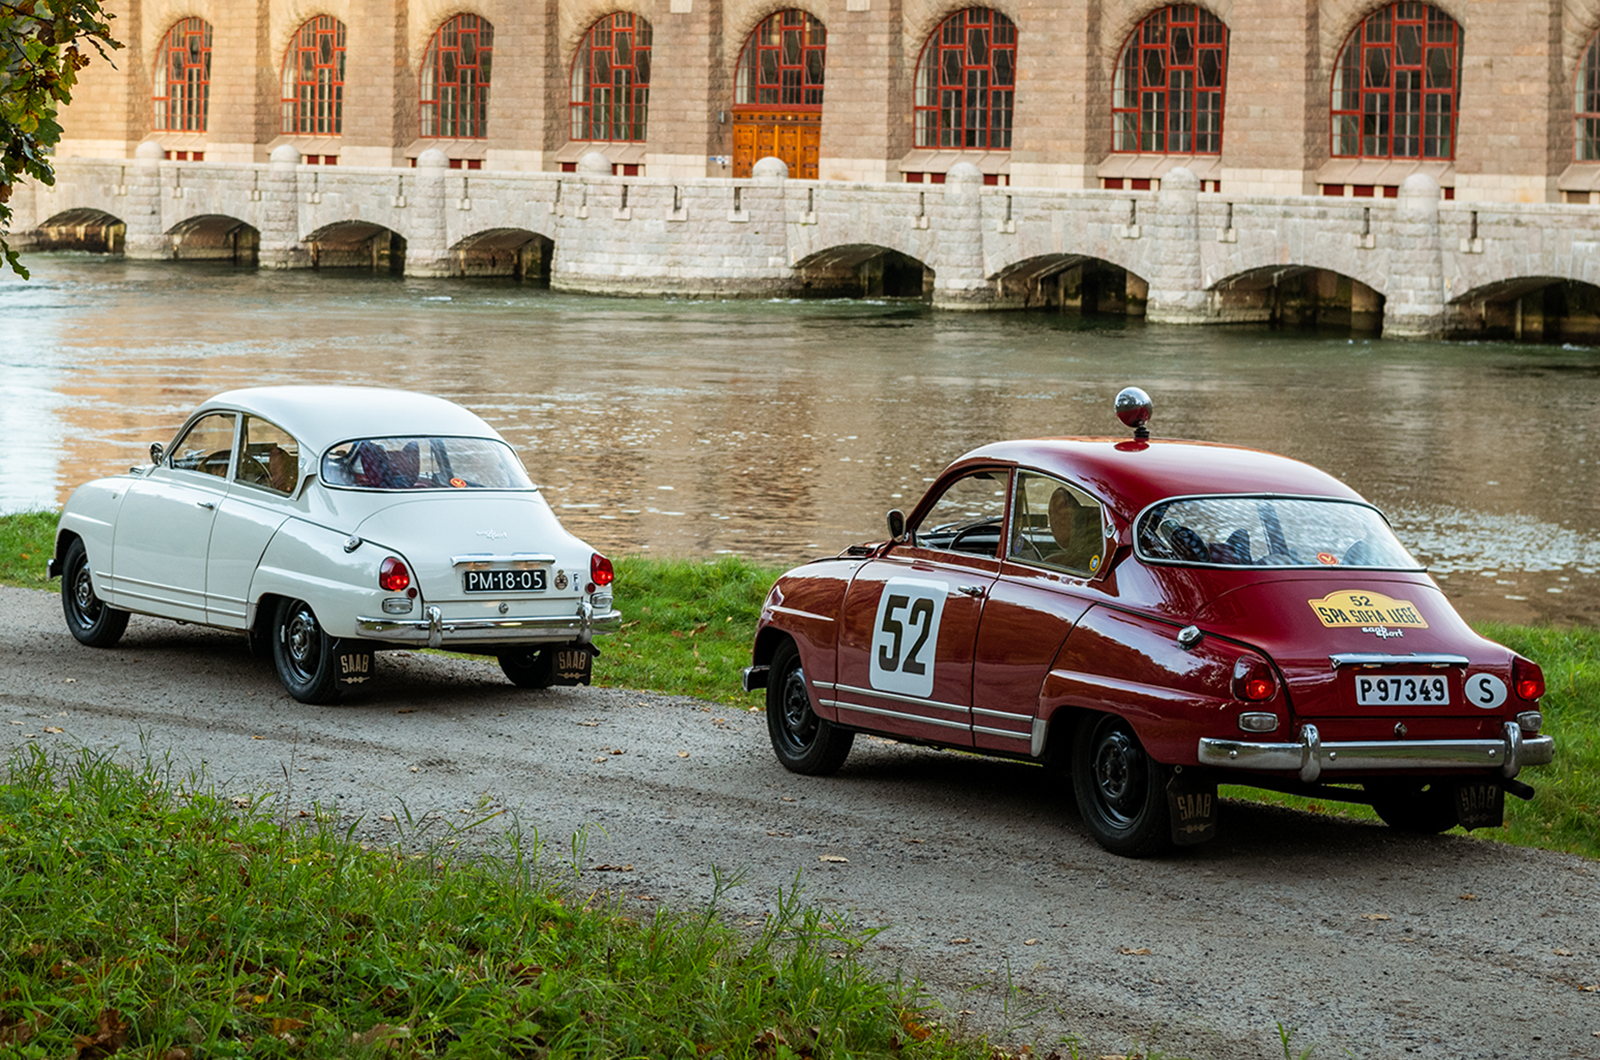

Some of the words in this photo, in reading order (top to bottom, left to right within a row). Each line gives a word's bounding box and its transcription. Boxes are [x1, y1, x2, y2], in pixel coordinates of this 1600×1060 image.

[469, 572, 543, 590] PM-18-05
[1349, 595, 1374, 607] 52
[1318, 606, 1351, 624] SPA
[1349, 609, 1388, 623] SOFIA
[1386, 606, 1422, 624] LIEGE
[878, 594, 935, 676] 52
[340, 653, 370, 673] SAAB
[558, 650, 587, 670] SAAB
[1479, 678, 1495, 704] S
[1176, 792, 1212, 821] SAAB
[1460, 785, 1497, 812] SAAB
